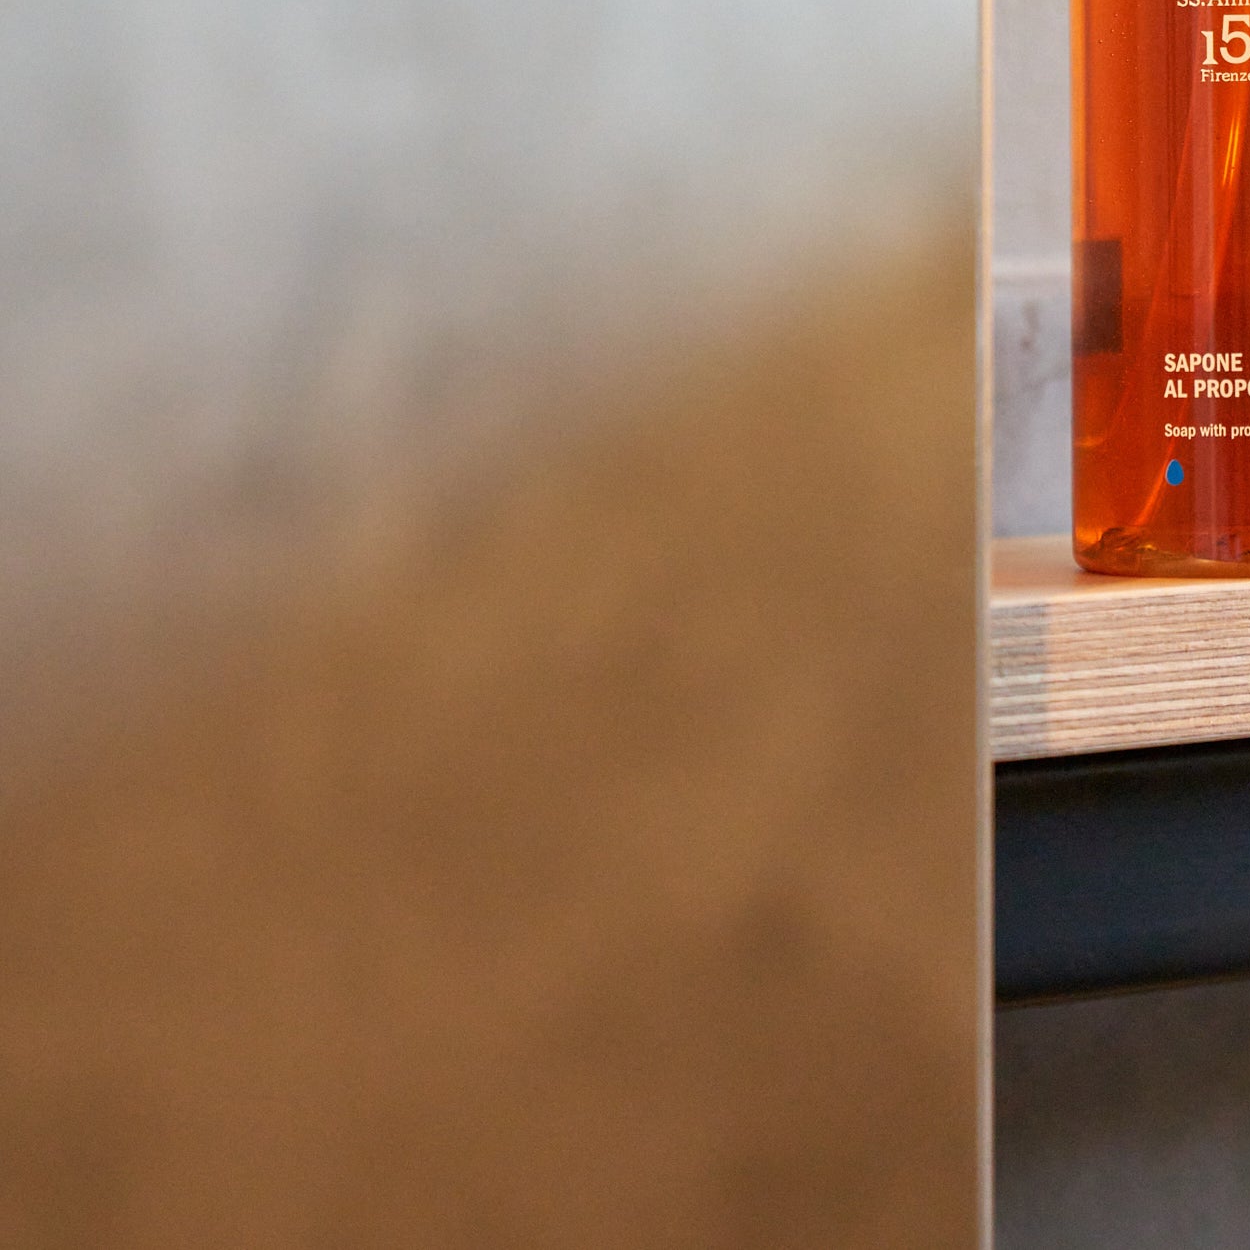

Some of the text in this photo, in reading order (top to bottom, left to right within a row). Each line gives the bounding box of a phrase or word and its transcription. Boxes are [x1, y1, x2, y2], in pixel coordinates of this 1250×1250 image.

[1164, 353, 1243, 372] SAPONE
[1164, 379, 1188, 398] AL
[1164, 423, 1196, 439] Soap
[1199, 423, 1227, 437] with
